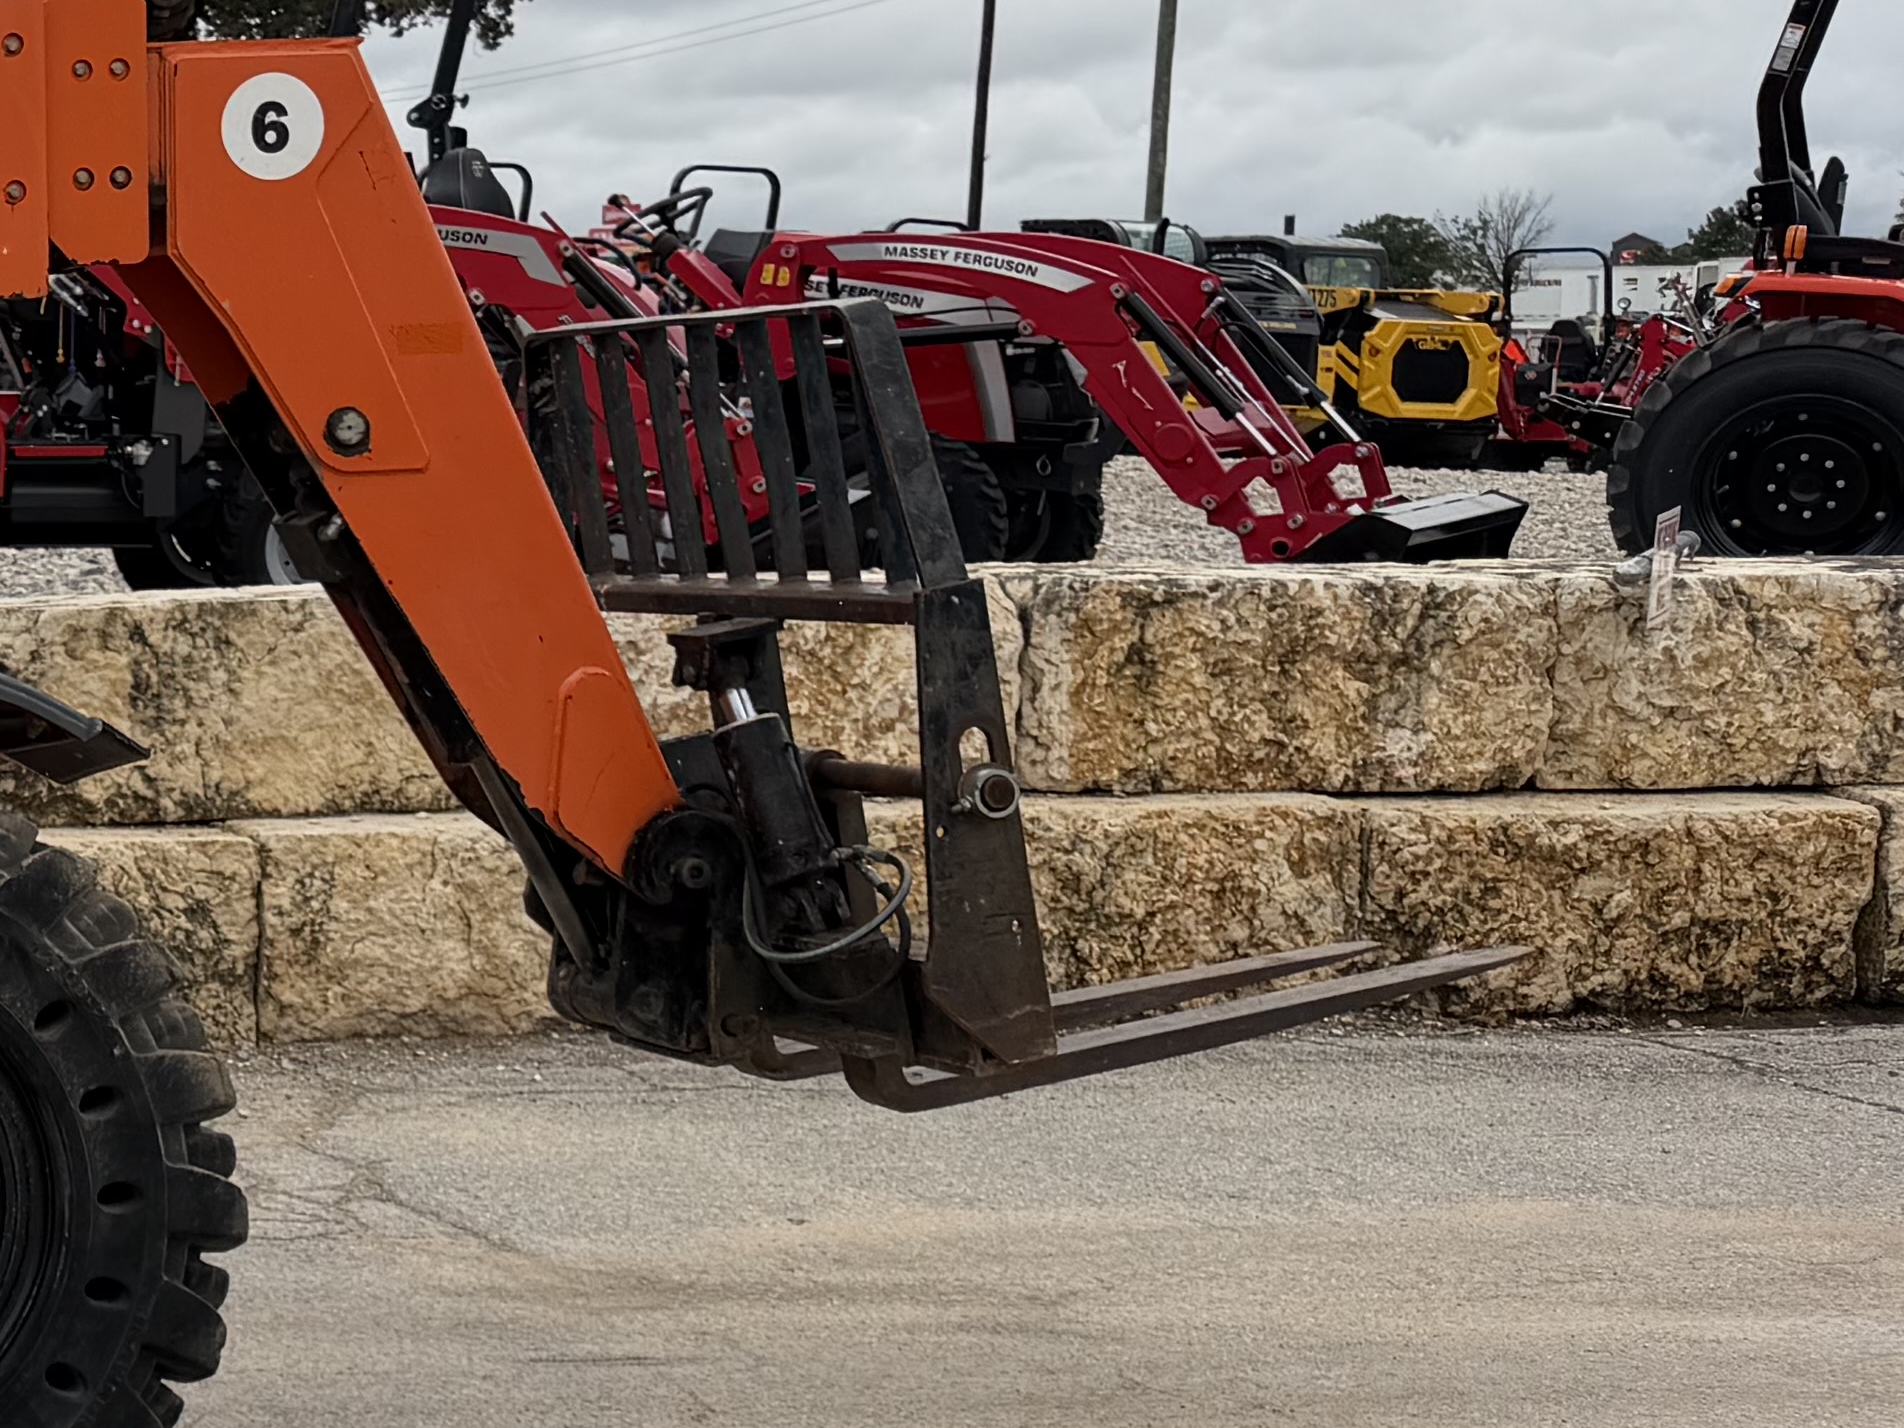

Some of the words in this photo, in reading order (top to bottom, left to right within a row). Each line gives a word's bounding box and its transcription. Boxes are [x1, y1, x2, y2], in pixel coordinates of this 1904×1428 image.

[251, 100, 290, 154] 6
[438, 228, 489, 246] USON
[883, 245, 950, 262] MASSEY
[953, 250, 1039, 278] FERGUSON
